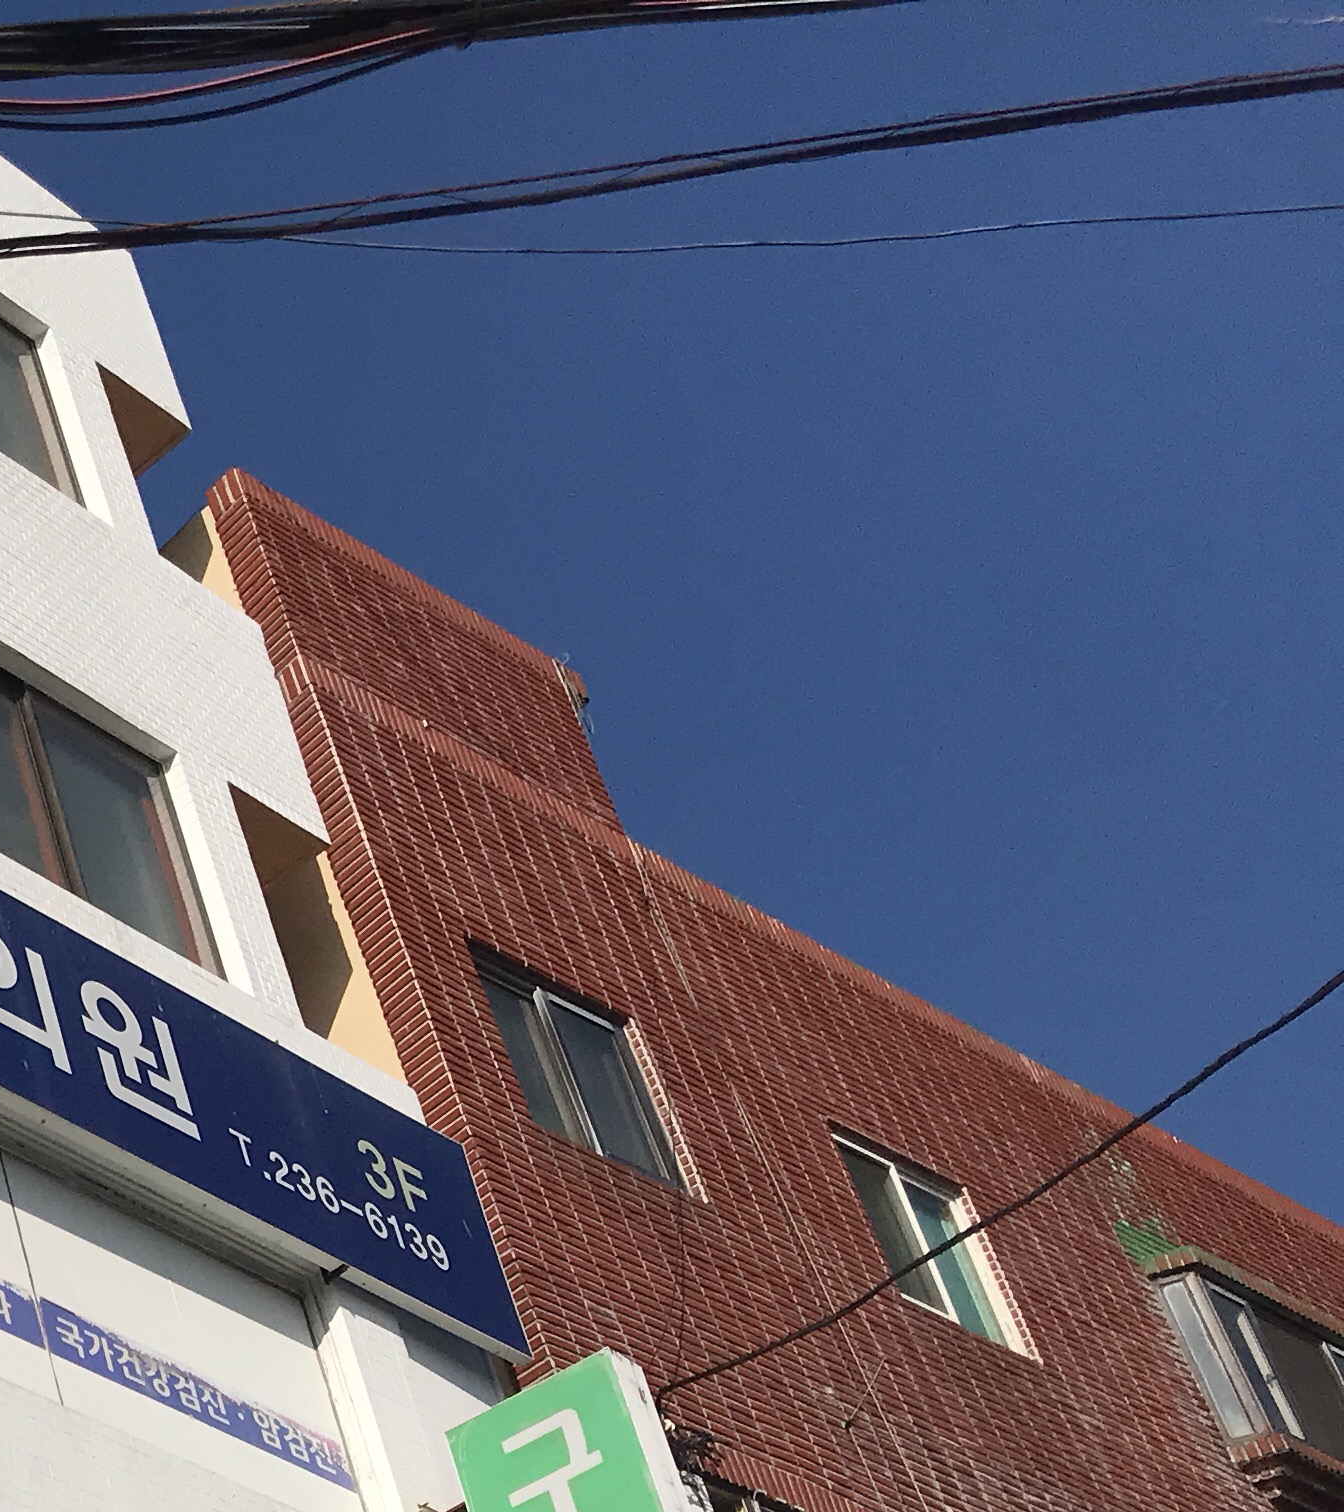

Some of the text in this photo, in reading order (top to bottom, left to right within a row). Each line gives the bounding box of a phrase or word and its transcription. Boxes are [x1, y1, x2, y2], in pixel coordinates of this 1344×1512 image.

[357, 1138, 428, 1213] 3F
[56, 1315, 231, 1426] 국가건강검진
[252, 1407, 338, 1476] 암검진
